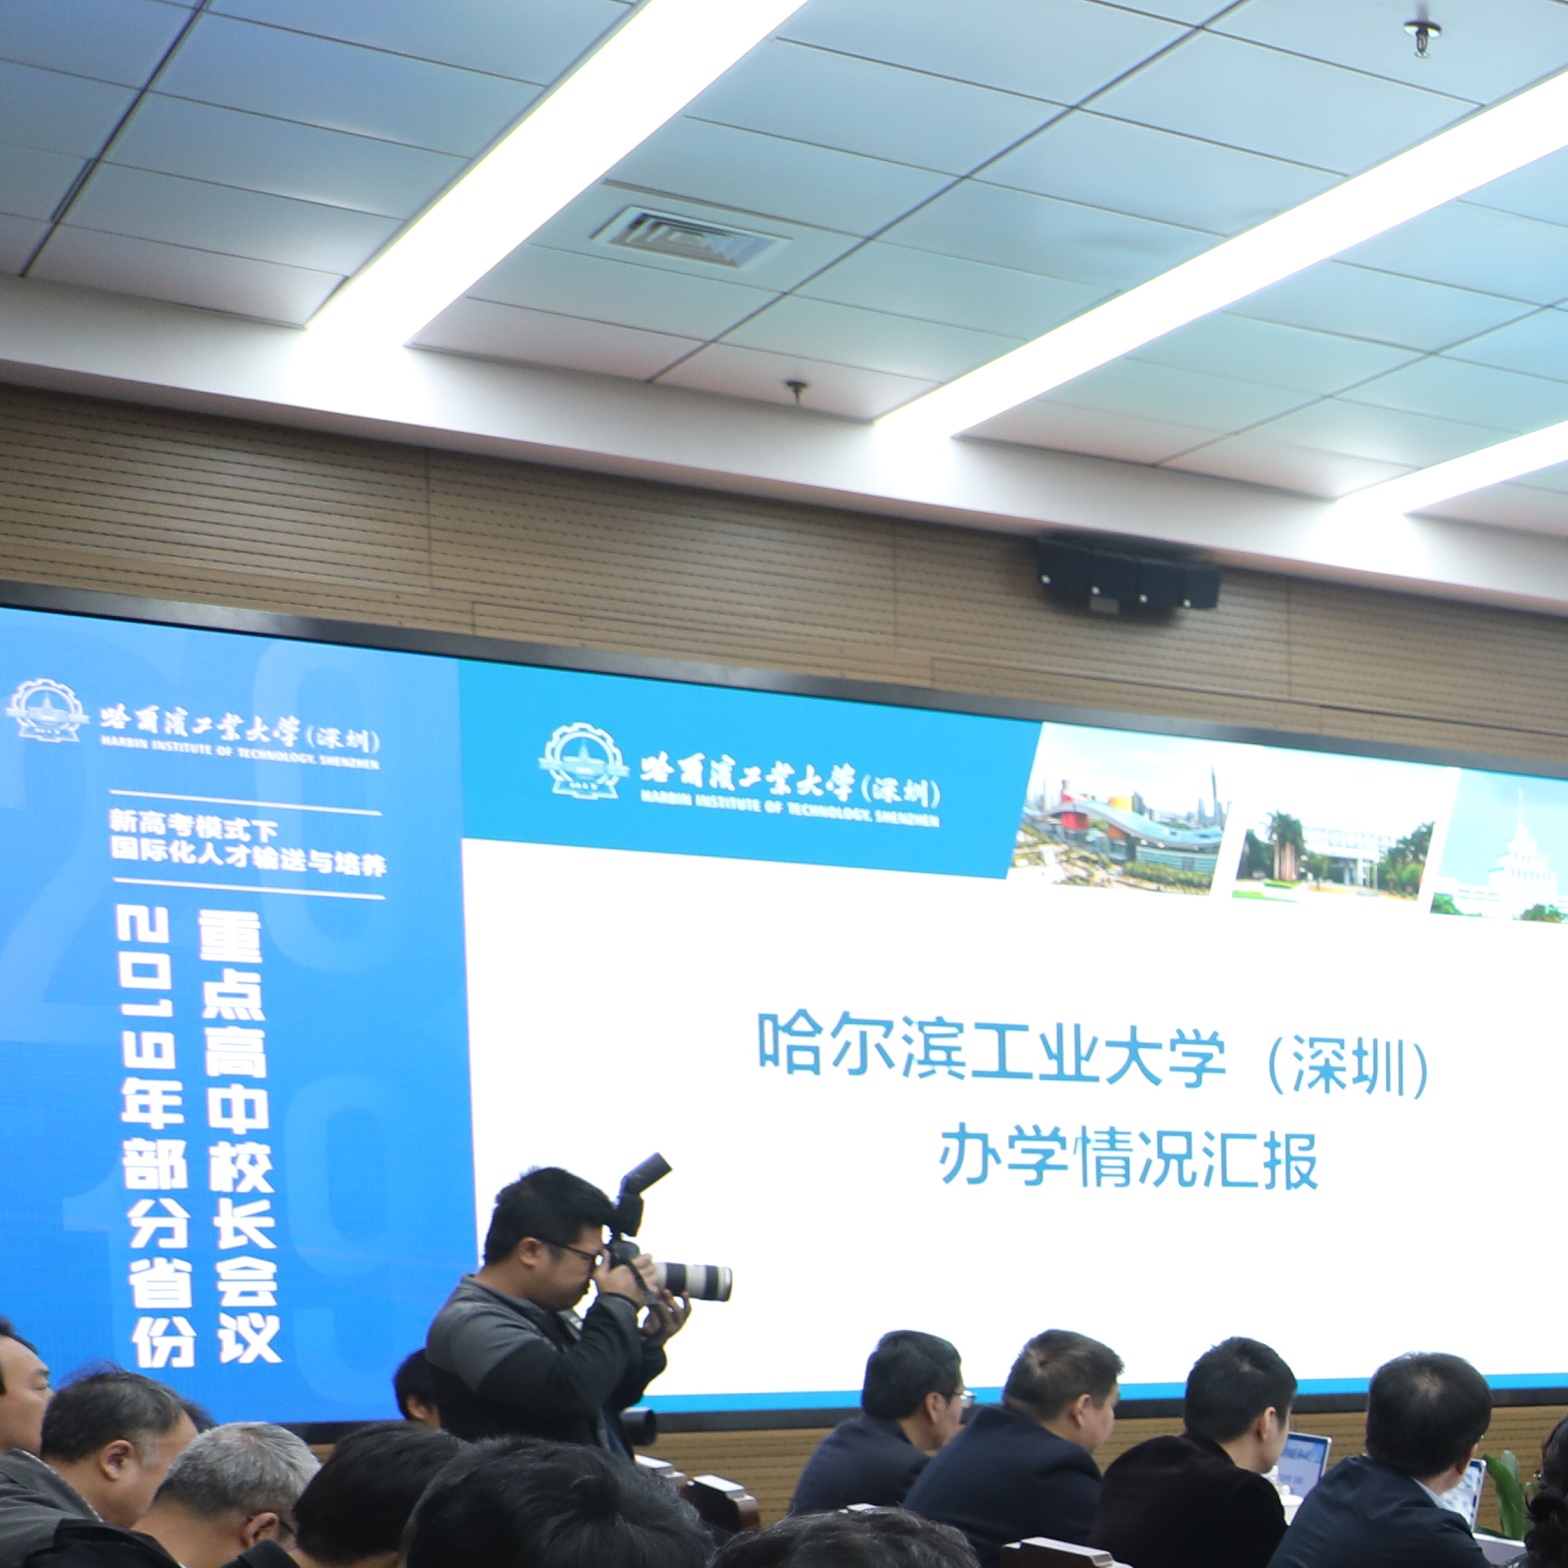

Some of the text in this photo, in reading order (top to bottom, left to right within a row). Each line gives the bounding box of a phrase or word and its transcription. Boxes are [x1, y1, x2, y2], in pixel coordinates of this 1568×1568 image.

[101, 735, 148, 749] HARBIN
[152, 739, 212, 756] INSTITUTE
[216, 745, 234, 757] OF
[108, 807, 279, 844] 新高考模式下
[764, 799, 783, 815] OF
[110, 836, 388, 878] 国际化人才输送与培养
[198, 907, 284, 1366] 重点高中校长会议
[938, 1121, 1320, 1192] 办学情况汇报
